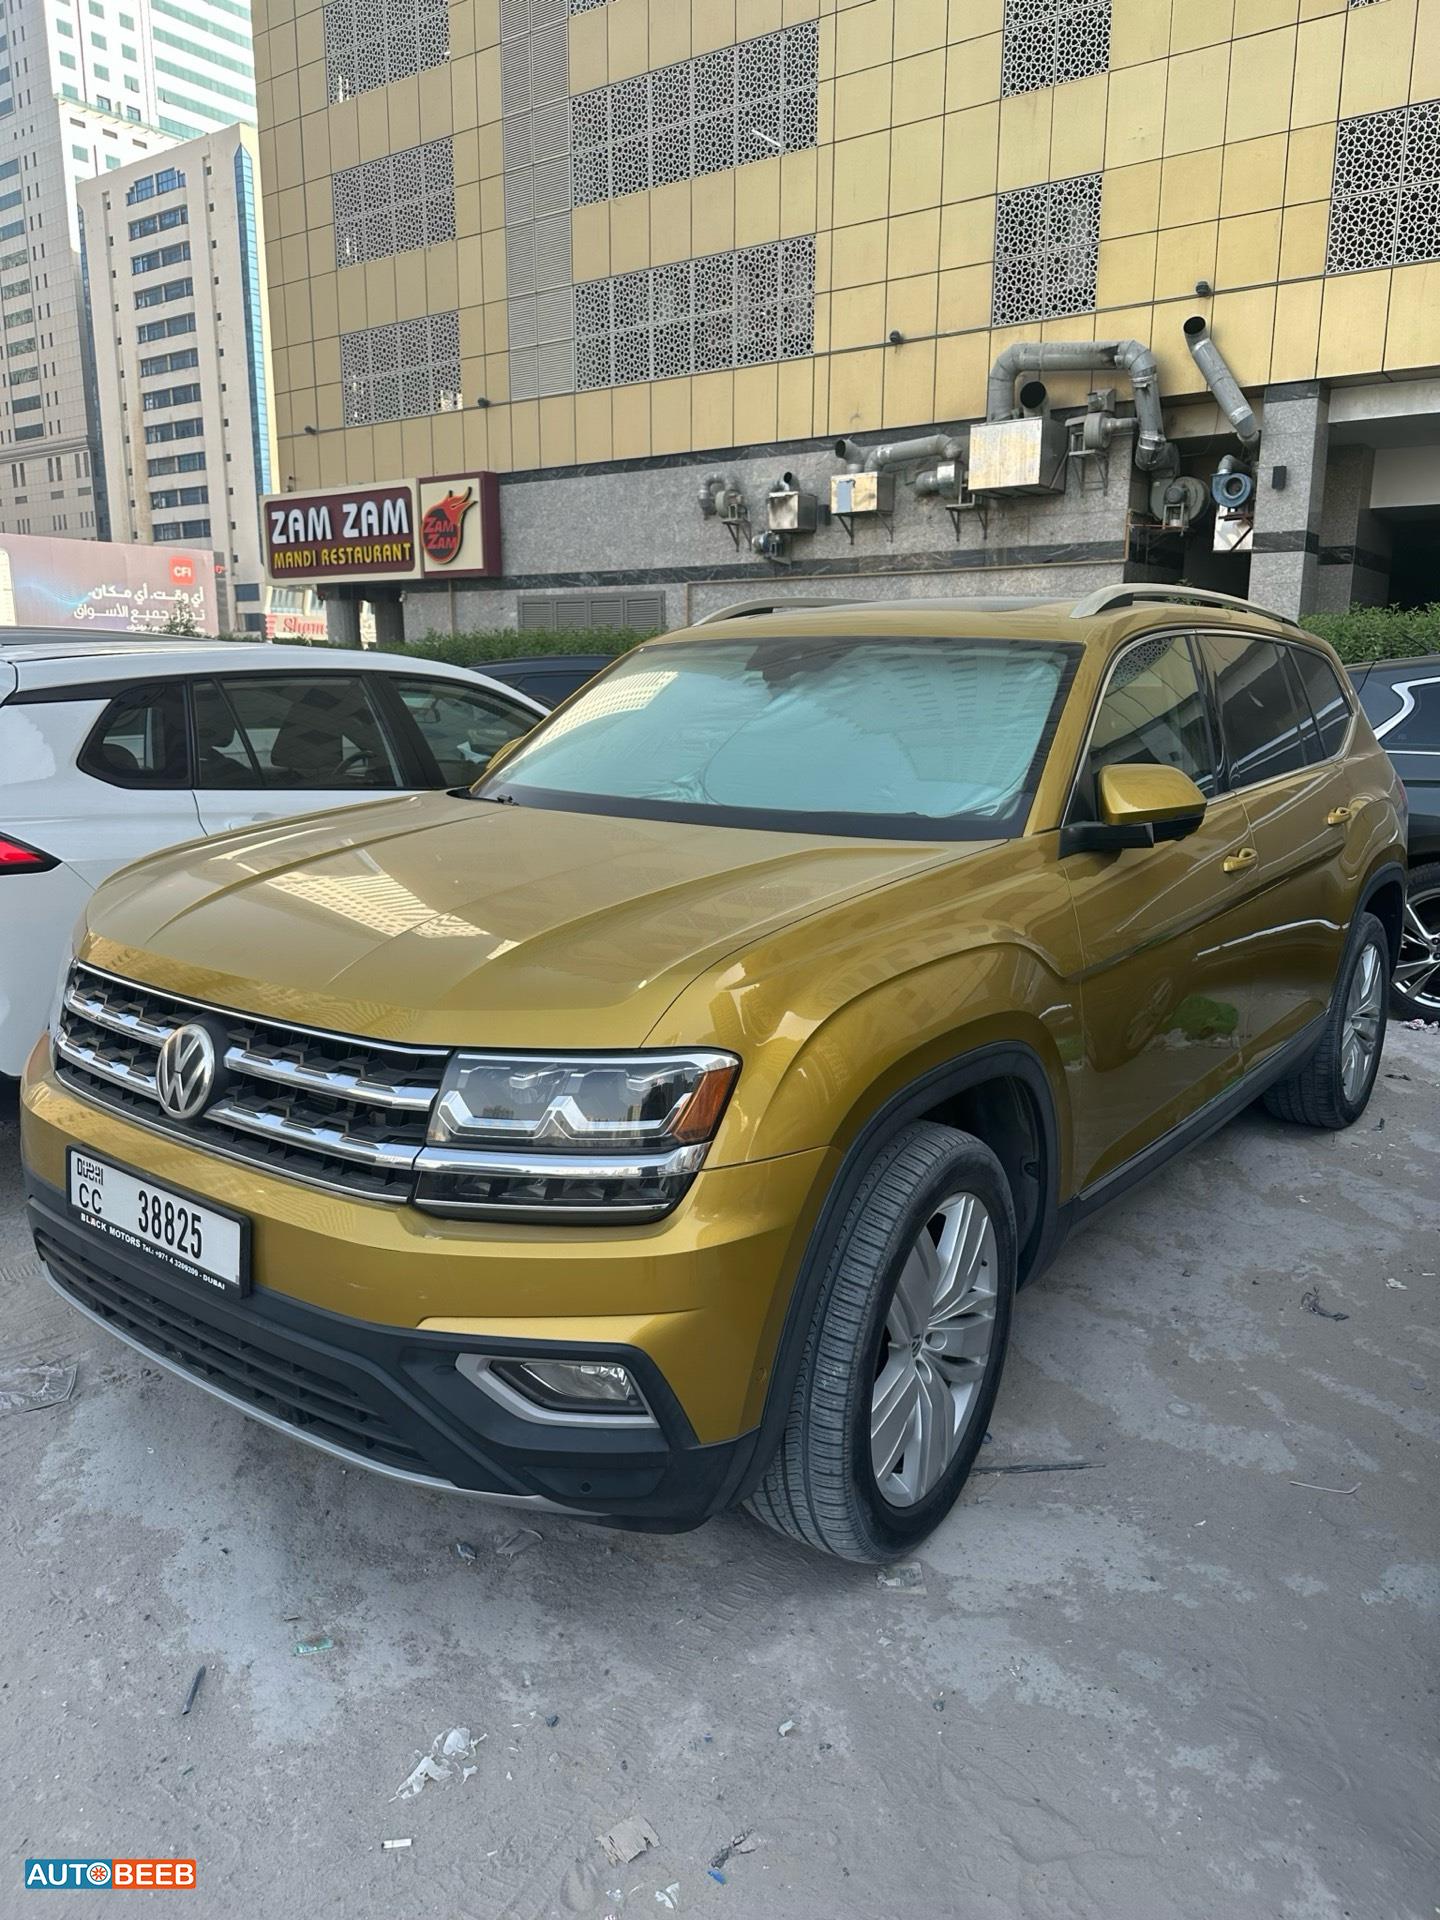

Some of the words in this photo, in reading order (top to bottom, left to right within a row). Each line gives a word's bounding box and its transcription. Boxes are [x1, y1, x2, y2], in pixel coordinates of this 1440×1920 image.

[271, 505, 332, 544] ZAM
[342, 498, 409, 538] ZAM
[274, 550, 317, 569] MANDI
[321, 543, 412, 566] RESTAURANT
[173, 566, 192, 577] CFI
[134, 583, 148, 605] أي
[74, 603, 129, 619] الأسواق
[130, 608, 169, 623] جميع
[79, 1183, 102, 1214] CC
[138, 1190, 203, 1259] 38825
[81, 1212, 107, 1231] BLACK
[109, 1227, 141, 1248] MOTORS
[202, 1273, 225, 1290] DUBAI
